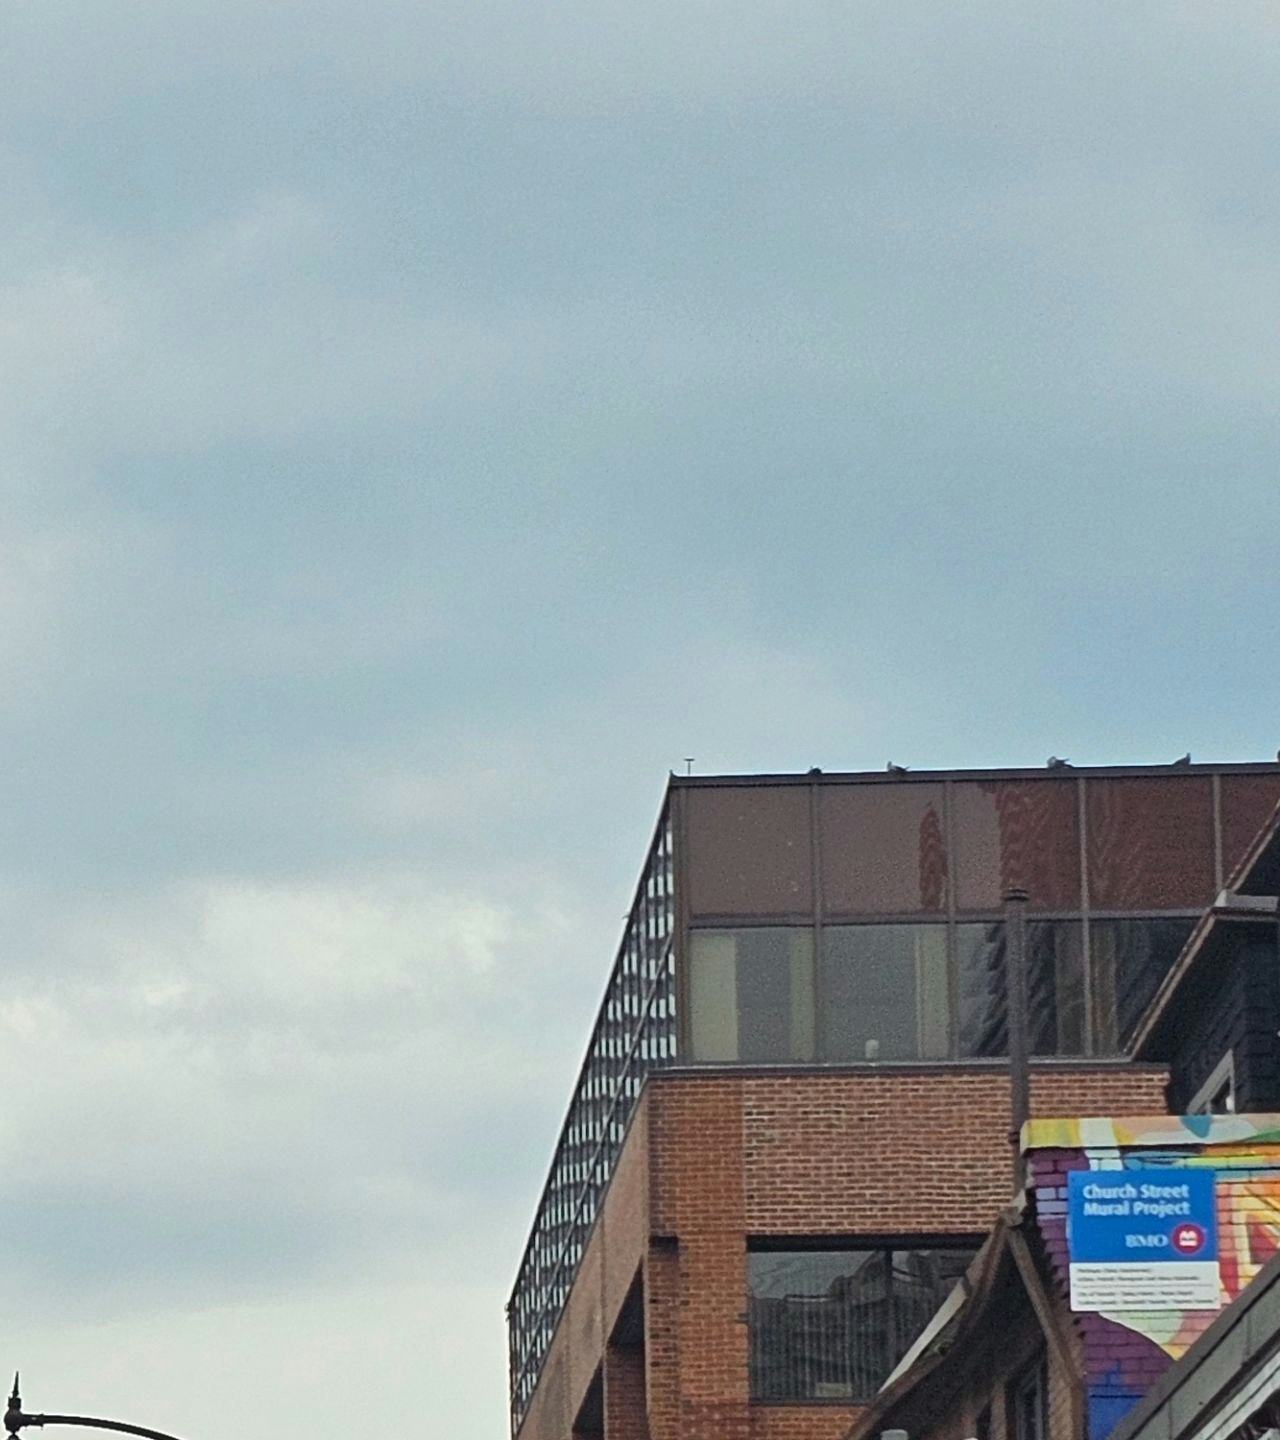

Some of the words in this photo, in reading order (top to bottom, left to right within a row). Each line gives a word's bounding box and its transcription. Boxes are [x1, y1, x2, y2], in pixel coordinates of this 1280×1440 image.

[1083, 1184, 1138, 1199] Church
[1141, 1184, 1190, 1198] Street
[1083, 1201, 1130, 1216] Mural
[1133, 1201, 1190, 1219] Project
[1125, 1234, 1168, 1248] BMO
